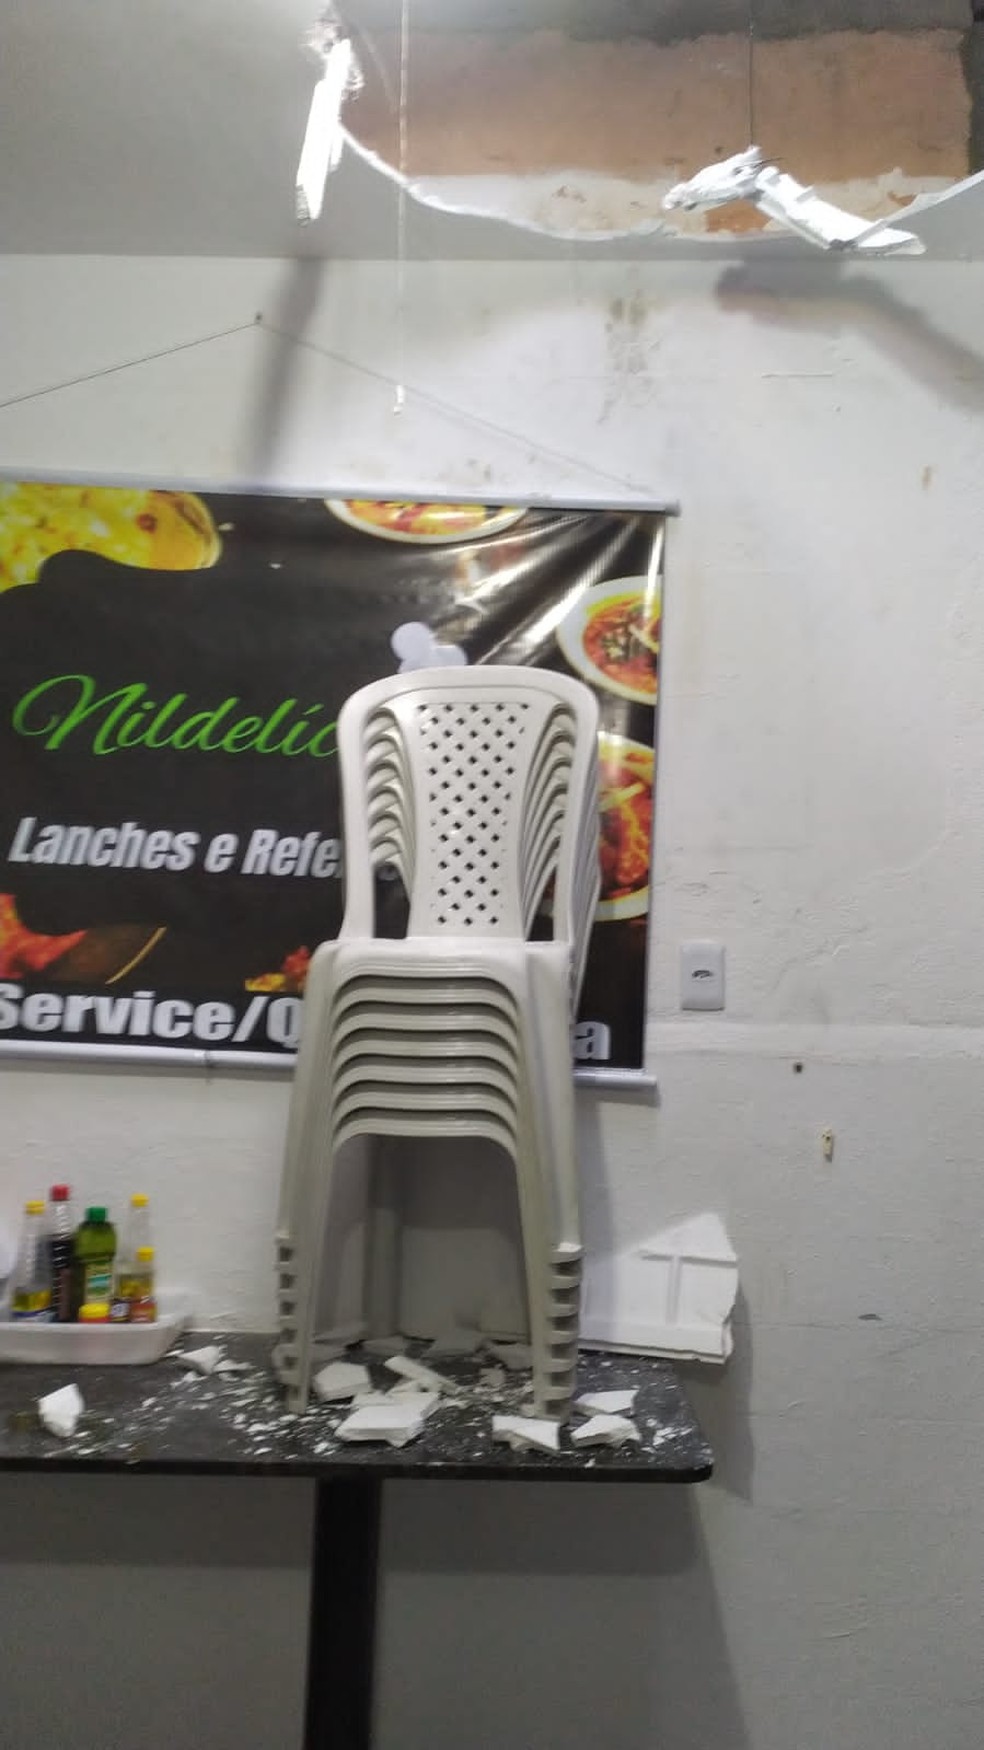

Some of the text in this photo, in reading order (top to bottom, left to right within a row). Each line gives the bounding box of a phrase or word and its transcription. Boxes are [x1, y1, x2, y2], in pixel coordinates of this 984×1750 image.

[8, 816, 344, 879] Lanches e Refe
